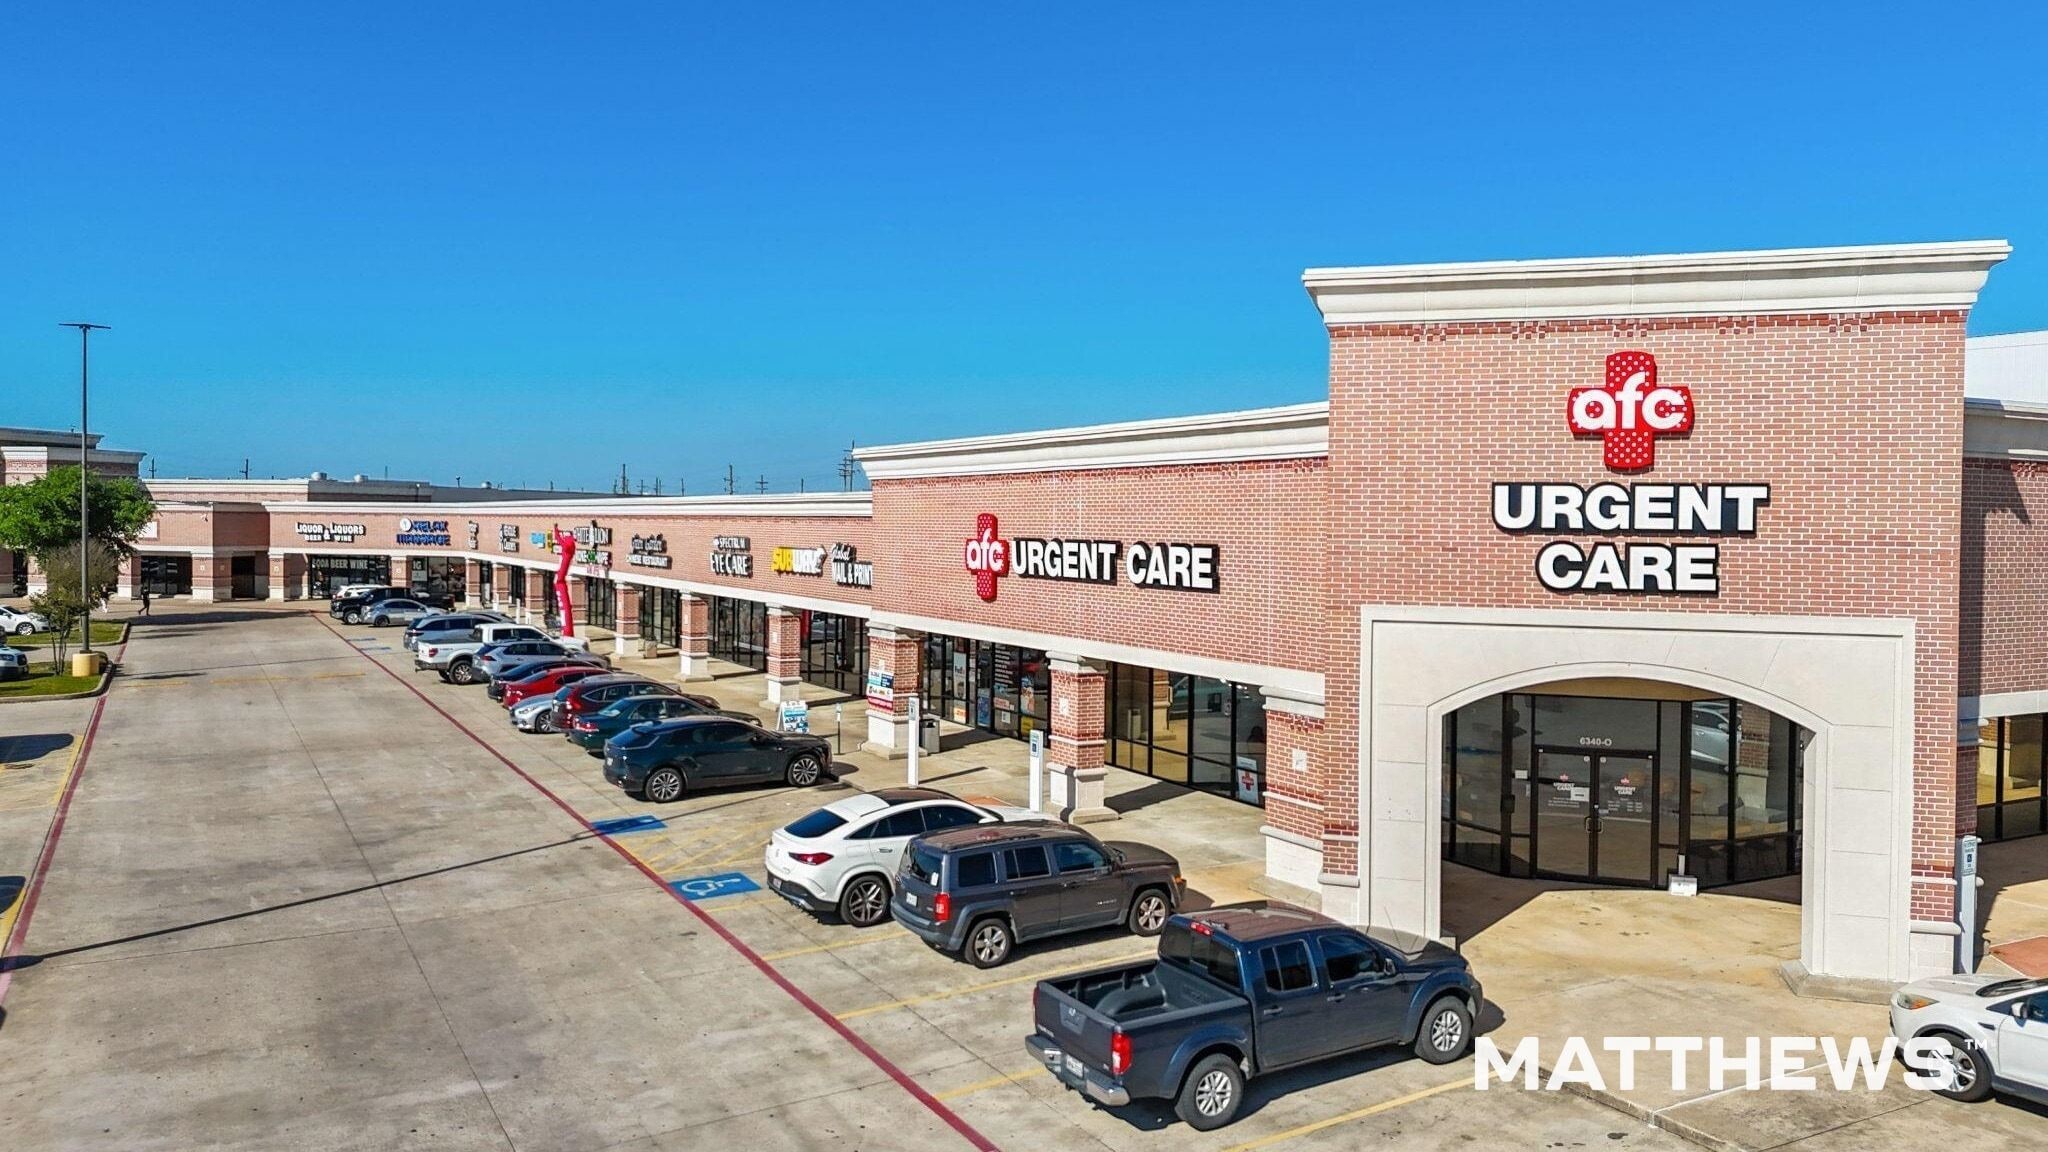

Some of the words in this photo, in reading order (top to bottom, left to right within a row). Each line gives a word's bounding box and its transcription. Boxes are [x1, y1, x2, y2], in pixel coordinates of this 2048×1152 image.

[1573, 371, 1686, 430] afc
[1493, 484, 1769, 532] URGENT
[295, 522, 323, 533] LIQUOR
[330, 522, 365, 534] LIQUORS
[594, 527, 609, 545] LION
[771, 547, 825, 574] SUBWAY
[966, 527, 1003, 572] afc
[330, 559, 348, 568] BEER
[349, 559, 368, 569] WINE
[710, 553, 724, 573] EYE
[725, 554, 748, 575] CARE
[1011, 539, 1118, 581] URGENT
[1126, 543, 1214, 589] CARE
[1538, 542, 1717, 592] CARE
[1579, 736, 1613, 747] 6340-O
